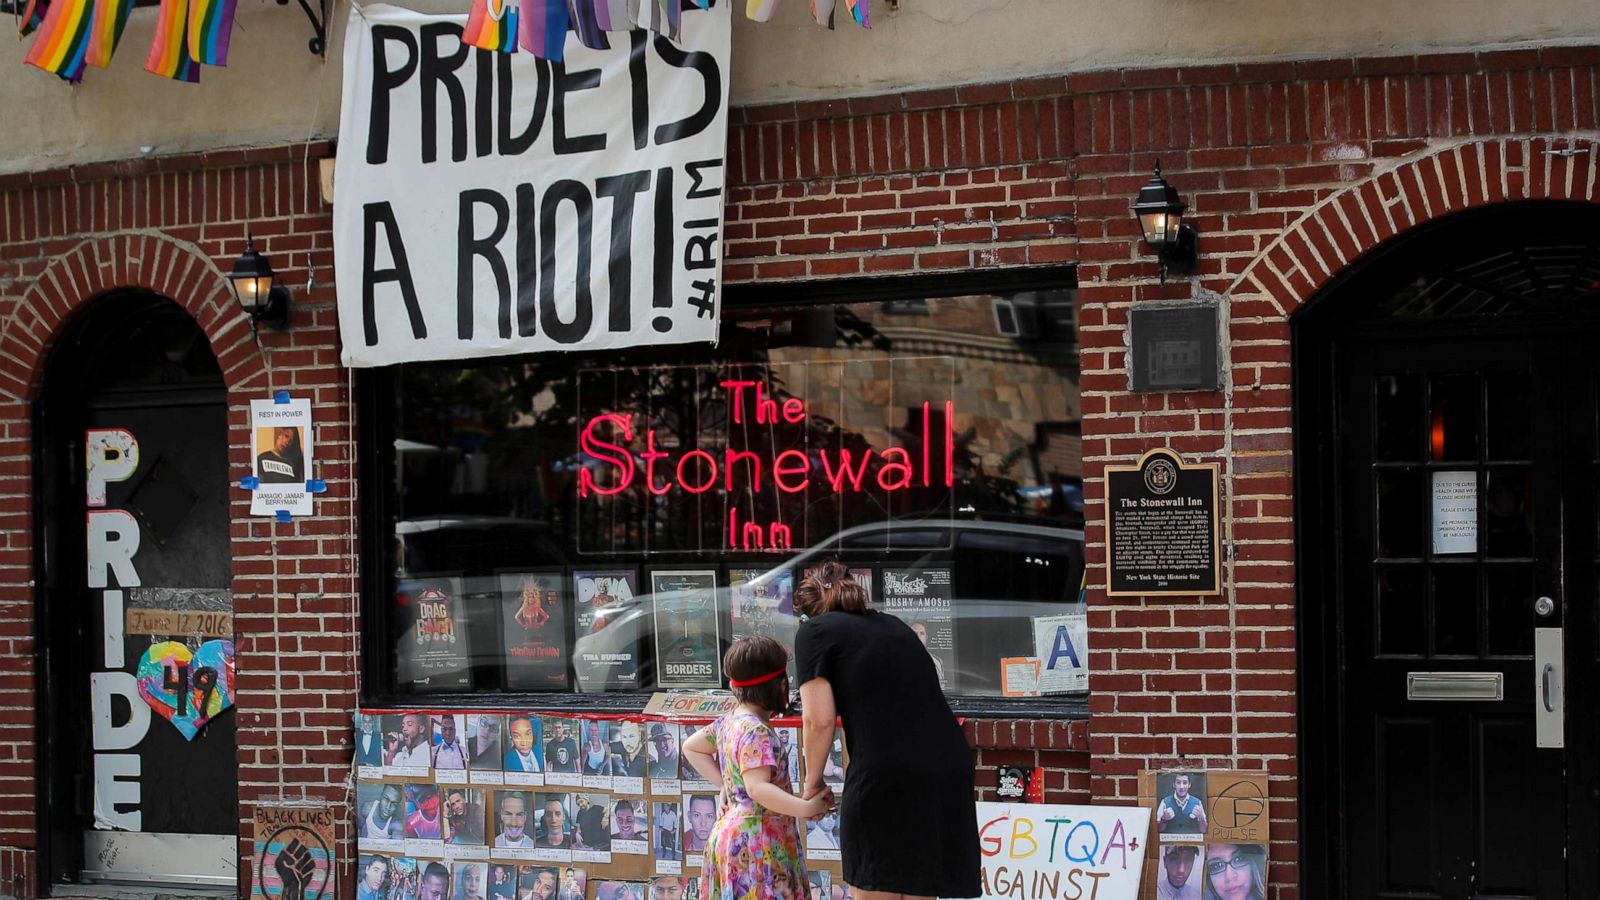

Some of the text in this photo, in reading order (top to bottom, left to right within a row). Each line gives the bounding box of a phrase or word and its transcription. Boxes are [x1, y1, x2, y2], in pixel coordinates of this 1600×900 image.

[366, 8, 721, 164] PRIDE IS
[363, 166, 674, 346] A RIOT!
[282, 410, 304, 418] POWER
[720, 380, 806, 424] The
[580, 400, 953, 498] Stonewall
[1120, 496, 1203, 508] The Stonewall Inn
[729, 506, 791, 550] Inn
[420, 602, 447, 619] DRAG
[886, 598, 914, 606] BUSHY
[85, 428, 151, 832] PRIDE
[197, 614, 227, 635] 2016
[1046, 626, 1080, 670] A
[666, 664, 712, 675] BORDERS
[164, 665, 218, 719] 49
[256, 808, 332, 827] BLACK LIVES
[1212, 828, 1258, 840] PULSE
